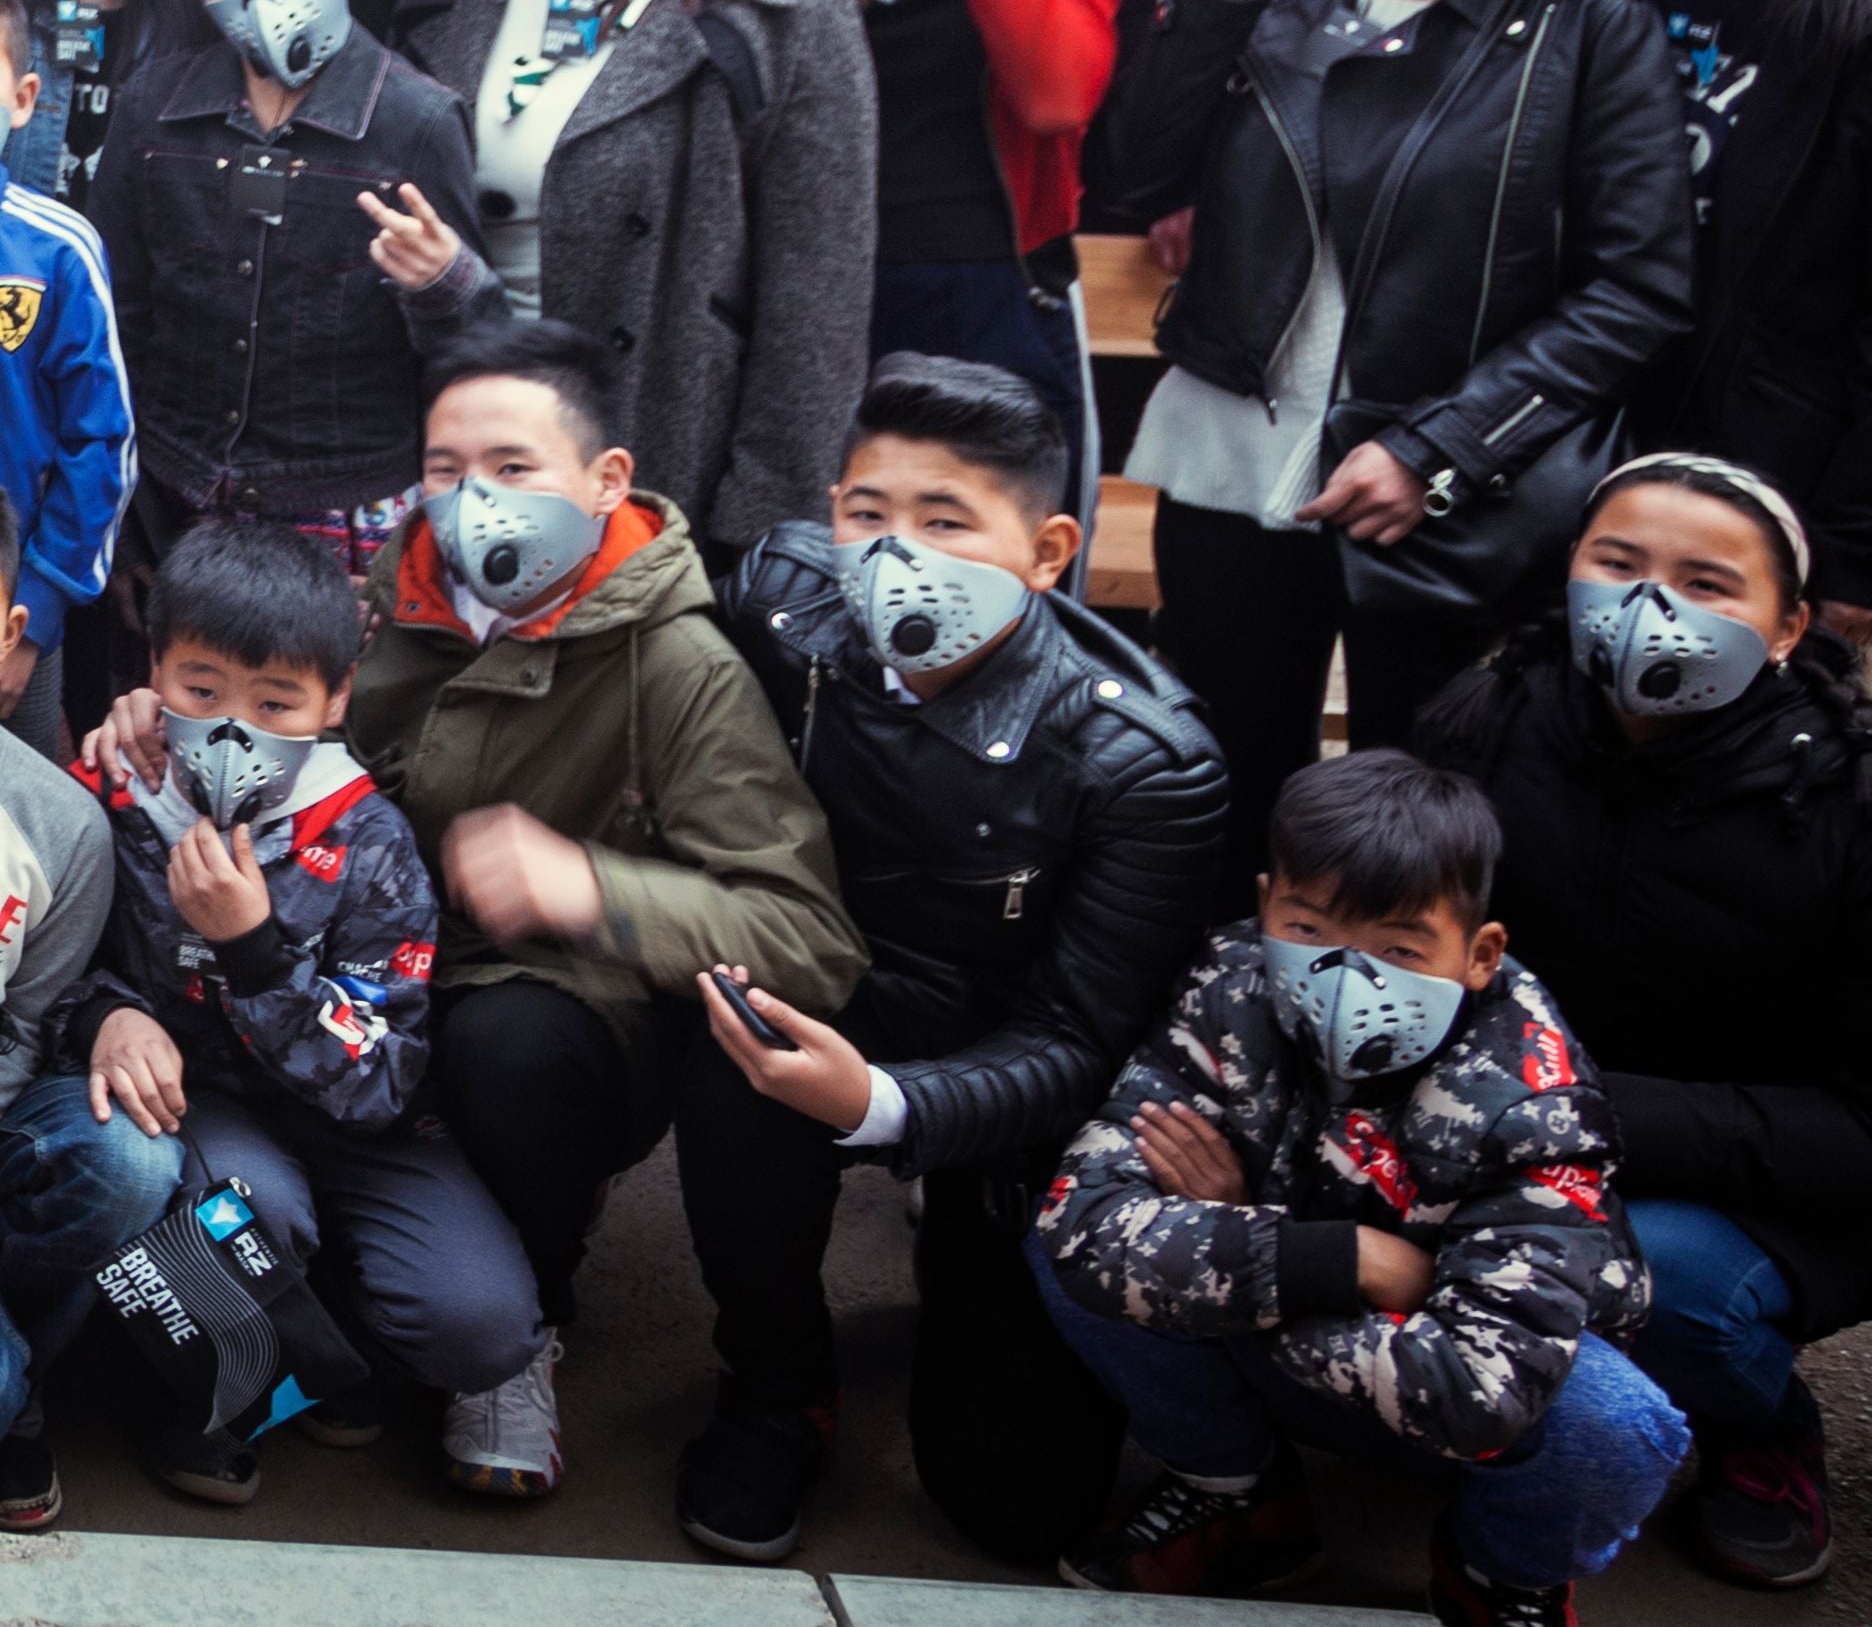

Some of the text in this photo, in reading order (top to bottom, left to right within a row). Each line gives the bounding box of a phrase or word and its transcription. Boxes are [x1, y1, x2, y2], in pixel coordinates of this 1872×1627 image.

[234, 1230, 272, 1276] RZ
[95, 1260, 148, 1319] SAFE
[120, 1246, 199, 1345] BREATHE
